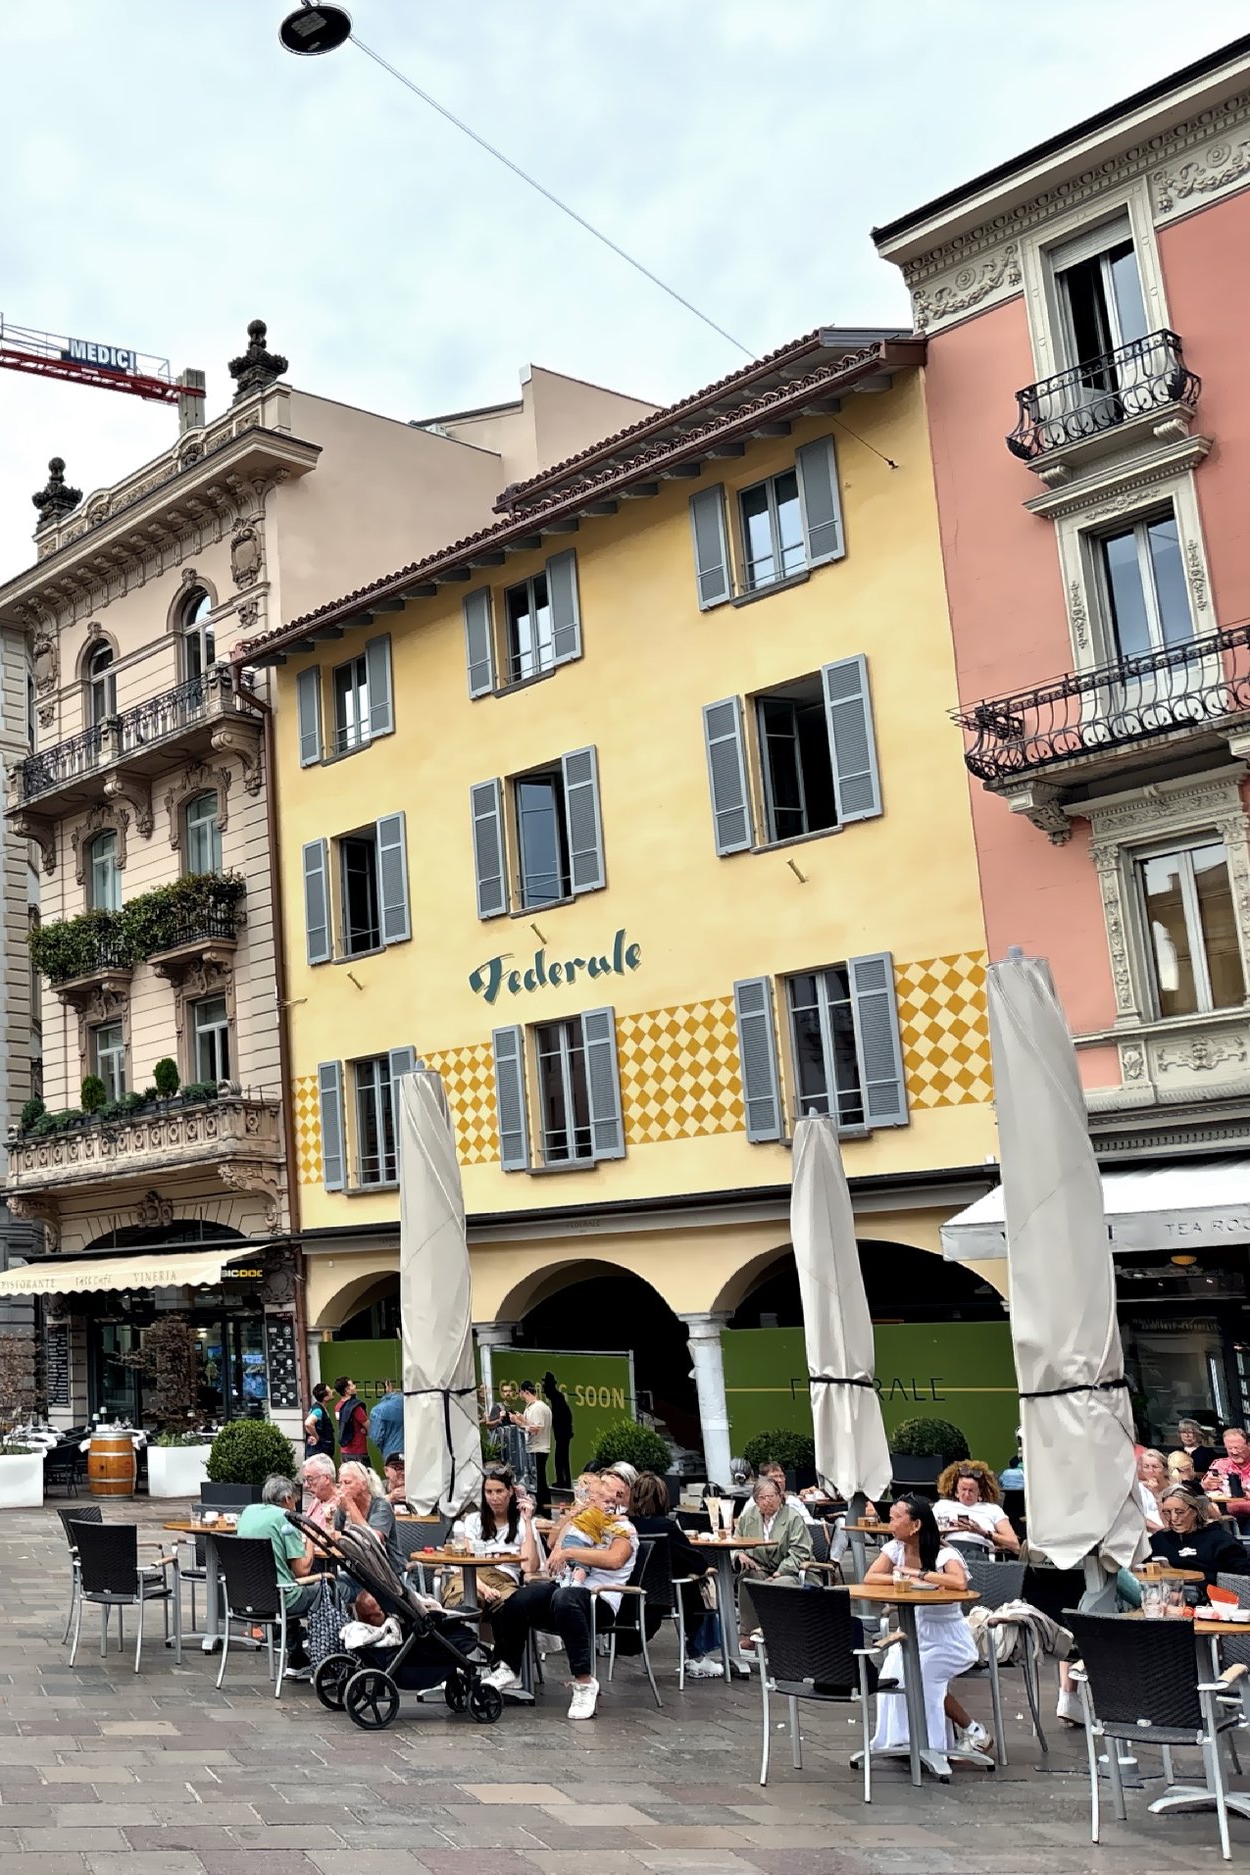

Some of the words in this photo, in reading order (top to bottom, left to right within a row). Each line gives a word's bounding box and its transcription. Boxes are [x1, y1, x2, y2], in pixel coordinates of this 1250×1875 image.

[70, 340, 135, 370] MEDICI
[469, 928, 642, 1006] Federale
[1164, 1222, 1203, 1236] TEA
[1, 1278, 55, 1290] RISTORANTE
[133, 1270, 178, 1282] VINERIA
[574, 1385, 625, 1409] SOON
